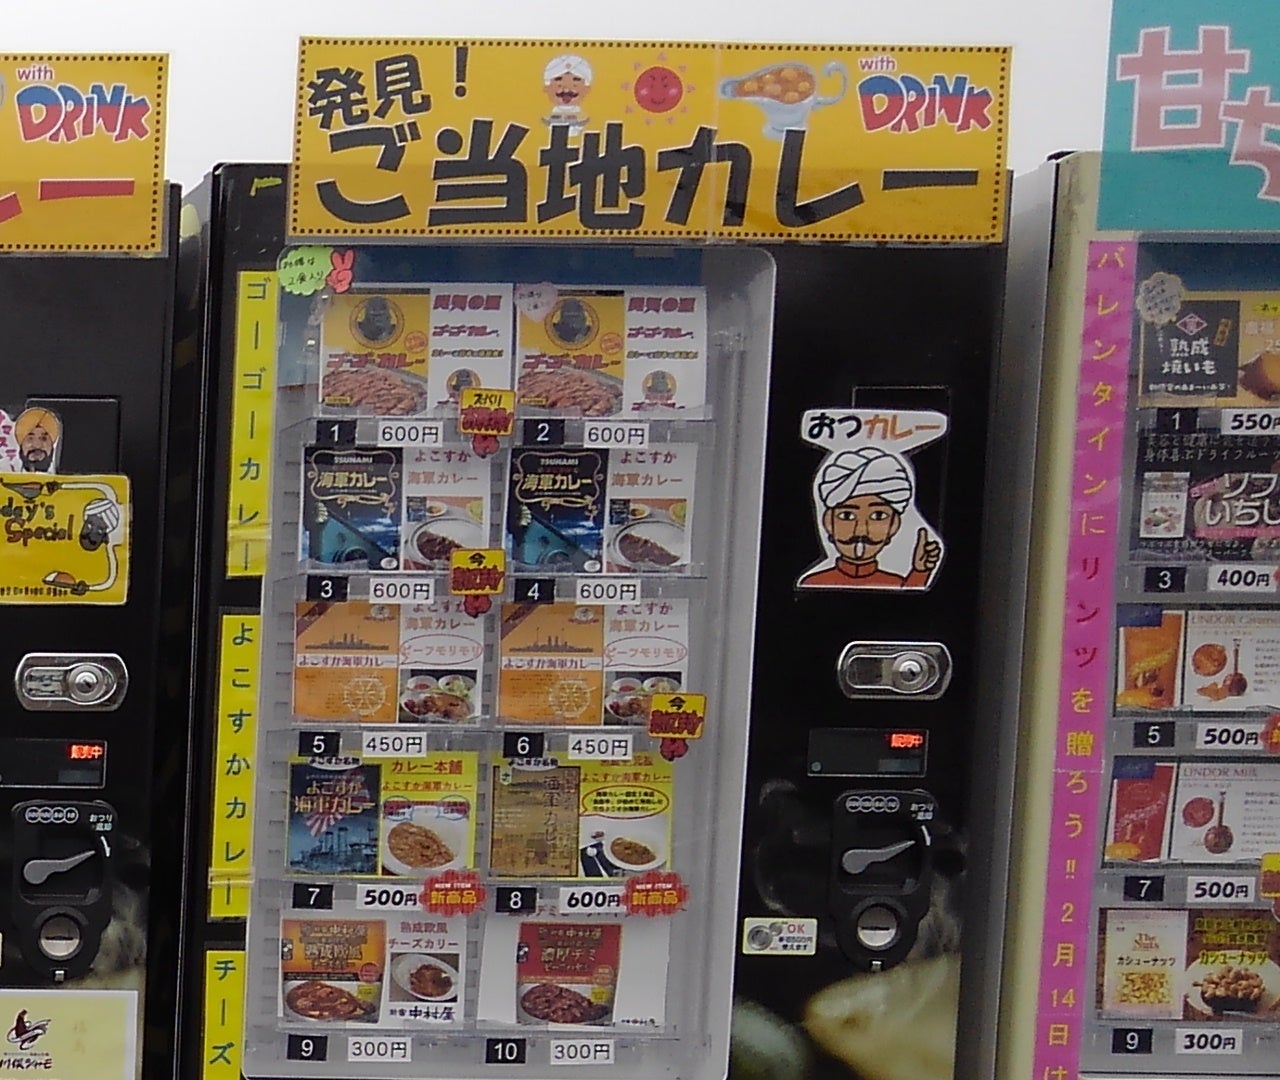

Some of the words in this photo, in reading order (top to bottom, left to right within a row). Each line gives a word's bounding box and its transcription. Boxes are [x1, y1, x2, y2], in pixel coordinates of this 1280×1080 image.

[17, 65, 53, 81] with
[860, 57, 895, 73] with
[317, 119, 978, 229] ご当地カレー
[238, 276, 272, 571] ゴーゴーカレー
[808, 411, 942, 441] おつカレー
[382, 426, 438, 443] 600円
[588, 427, 645, 445] 600円
[620, 451, 676, 464] よこすか
[5, 513, 75, 547] Special
[1217, 570, 1270, 586] 400円
[374, 583, 430, 600] 600円
[580, 584, 636, 601] 600円
[366, 737, 422, 753] 450円
[1204, 728, 1259, 745] 500円
[572, 739, 628, 756] 450円
[225, 622, 254, 905] よこすかカレー
[364, 890, 417, 906] 500円
[1195, 882, 1248, 898] 500円
[567, 892, 623, 908] 600円
[352, 1041, 407, 1058] 300円
[1184, 1034, 1235, 1049] 300円
[554, 1044, 610, 1060] 300円
